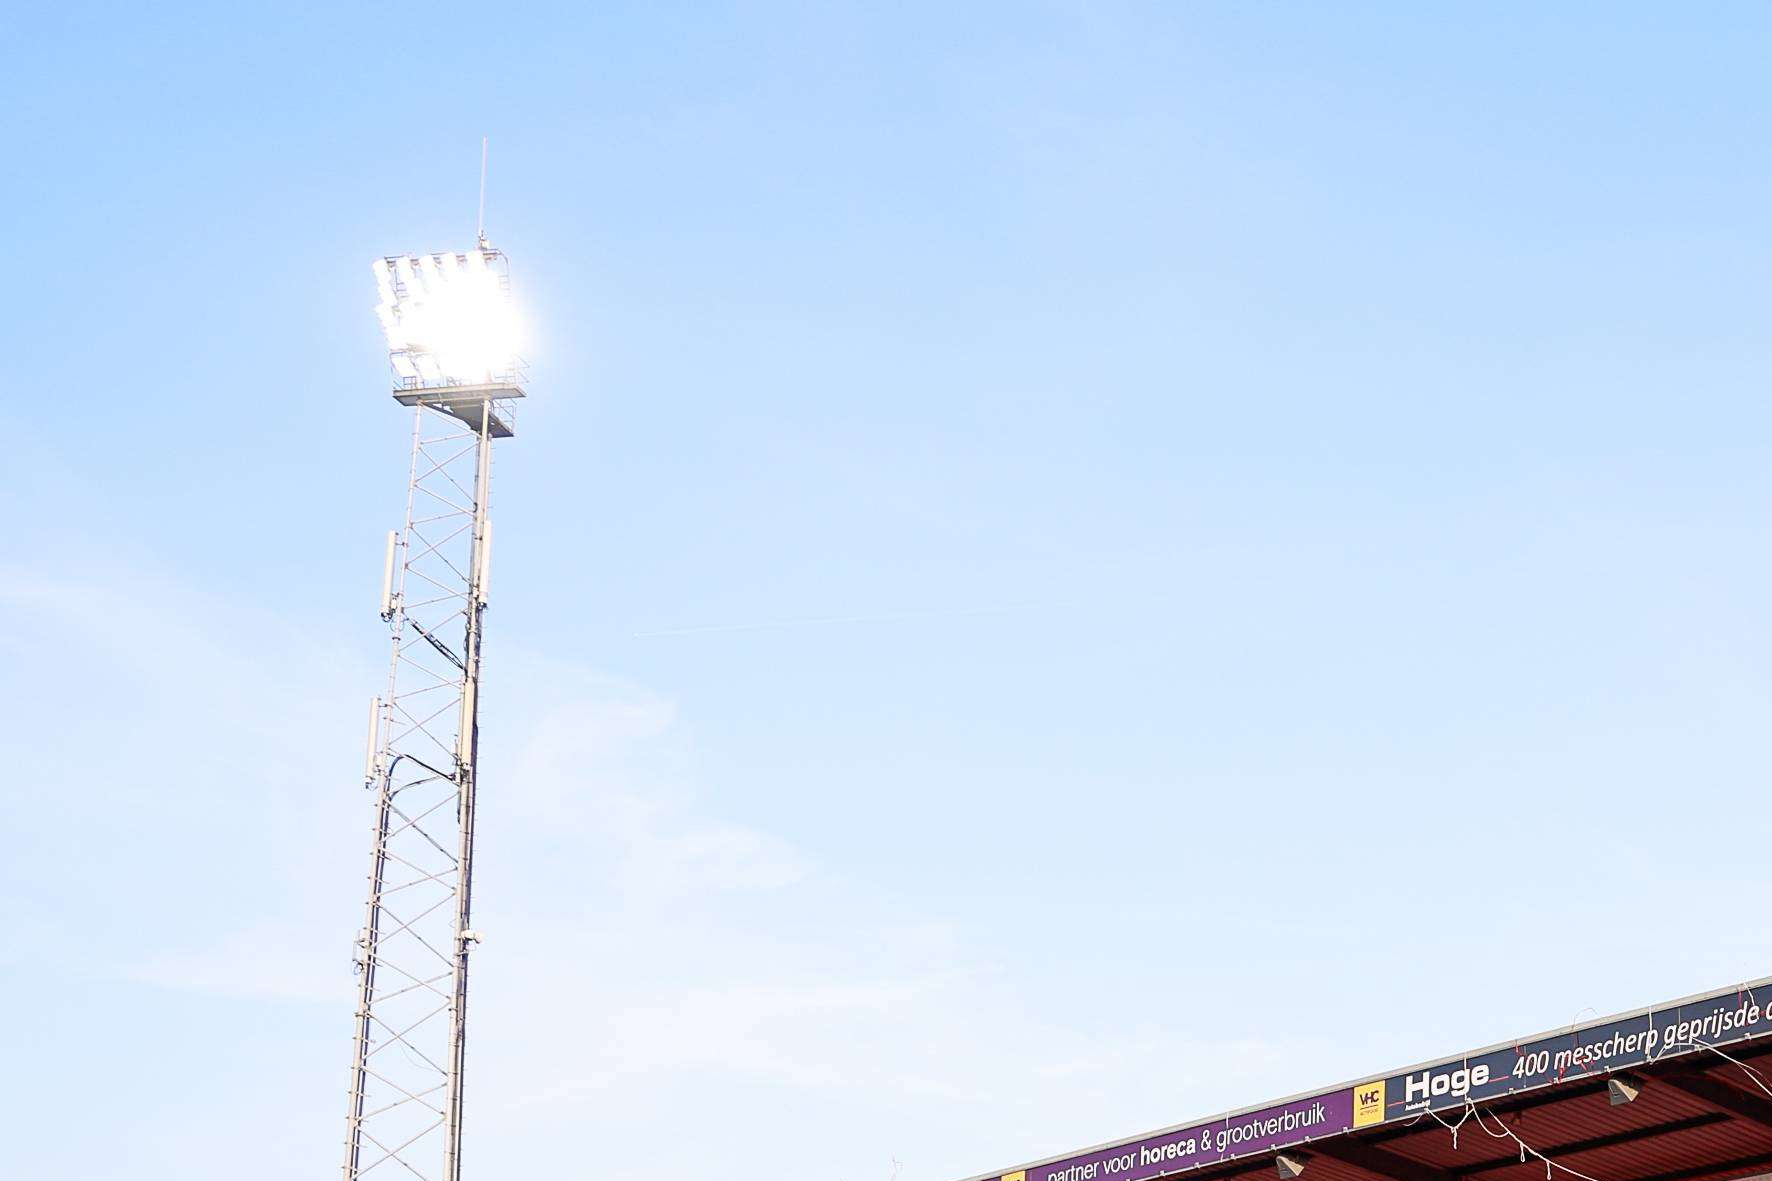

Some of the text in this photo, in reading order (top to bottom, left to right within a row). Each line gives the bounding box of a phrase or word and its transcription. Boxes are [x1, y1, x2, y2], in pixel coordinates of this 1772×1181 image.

[1511, 1050, 1549, 1080] 400
[1553, 1027, 1659, 1072] messcherp
[1664, 1001, 1760, 1050] geprijsde
[1360, 1090, 1379, 1106] VHC
[1405, 1064, 1490, 1102] Hoge
[1102, 1149, 1137, 1174] voor
[1140, 1136, 1197, 1167] horeca
[1199, 1130, 1213, 1152] &
[1216, 1101, 1326, 1152] grootverbruik
